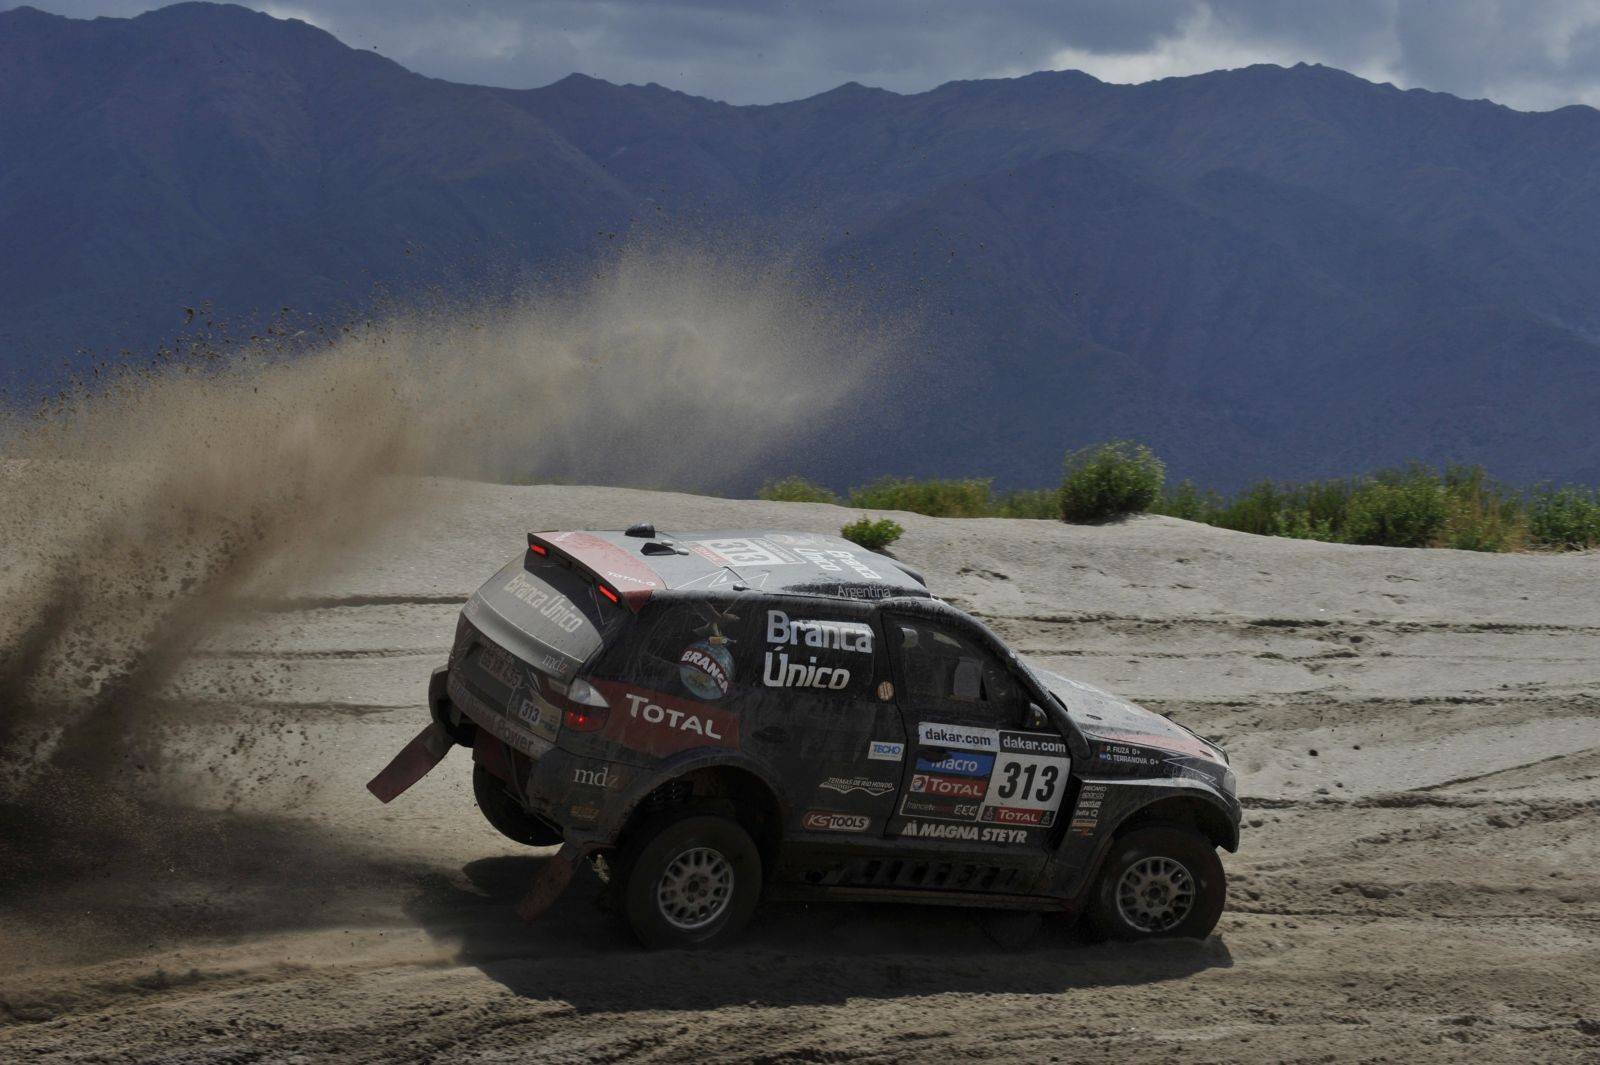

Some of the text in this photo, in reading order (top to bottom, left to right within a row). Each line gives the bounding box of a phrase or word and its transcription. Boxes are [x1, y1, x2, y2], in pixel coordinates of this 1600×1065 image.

[710, 542, 770, 562] 313
[503, 573, 546, 609] Branca
[837, 585, 891, 600] Argentina
[767, 609, 873, 654] Branca
[541, 654, 569, 674] mdz
[680, 650, 728, 694] BRANCA
[763, 646, 851, 690] Único
[521, 702, 540, 722] 313
[625, 693, 722, 740] TOTAL
[496, 717, 534, 750] Power
[925, 728, 991, 746] dakar.com
[873, 744, 901, 754] TECHO
[1003, 735, 1067, 753] dakar.com
[1112, 746, 1130, 754] FIUZA
[1113, 755, 1148, 765] TERRANOVA
[572, 766, 620, 789] mdz
[828, 777, 853, 786] TERMAS
[930, 778, 983, 796] TOTAL
[998, 761, 1059, 802] 313
[807, 814, 865, 828] KS TOOLS
[999, 809, 1039, 823] TOTAL
[919, 823, 1028, 844] MAGNA STEYR
